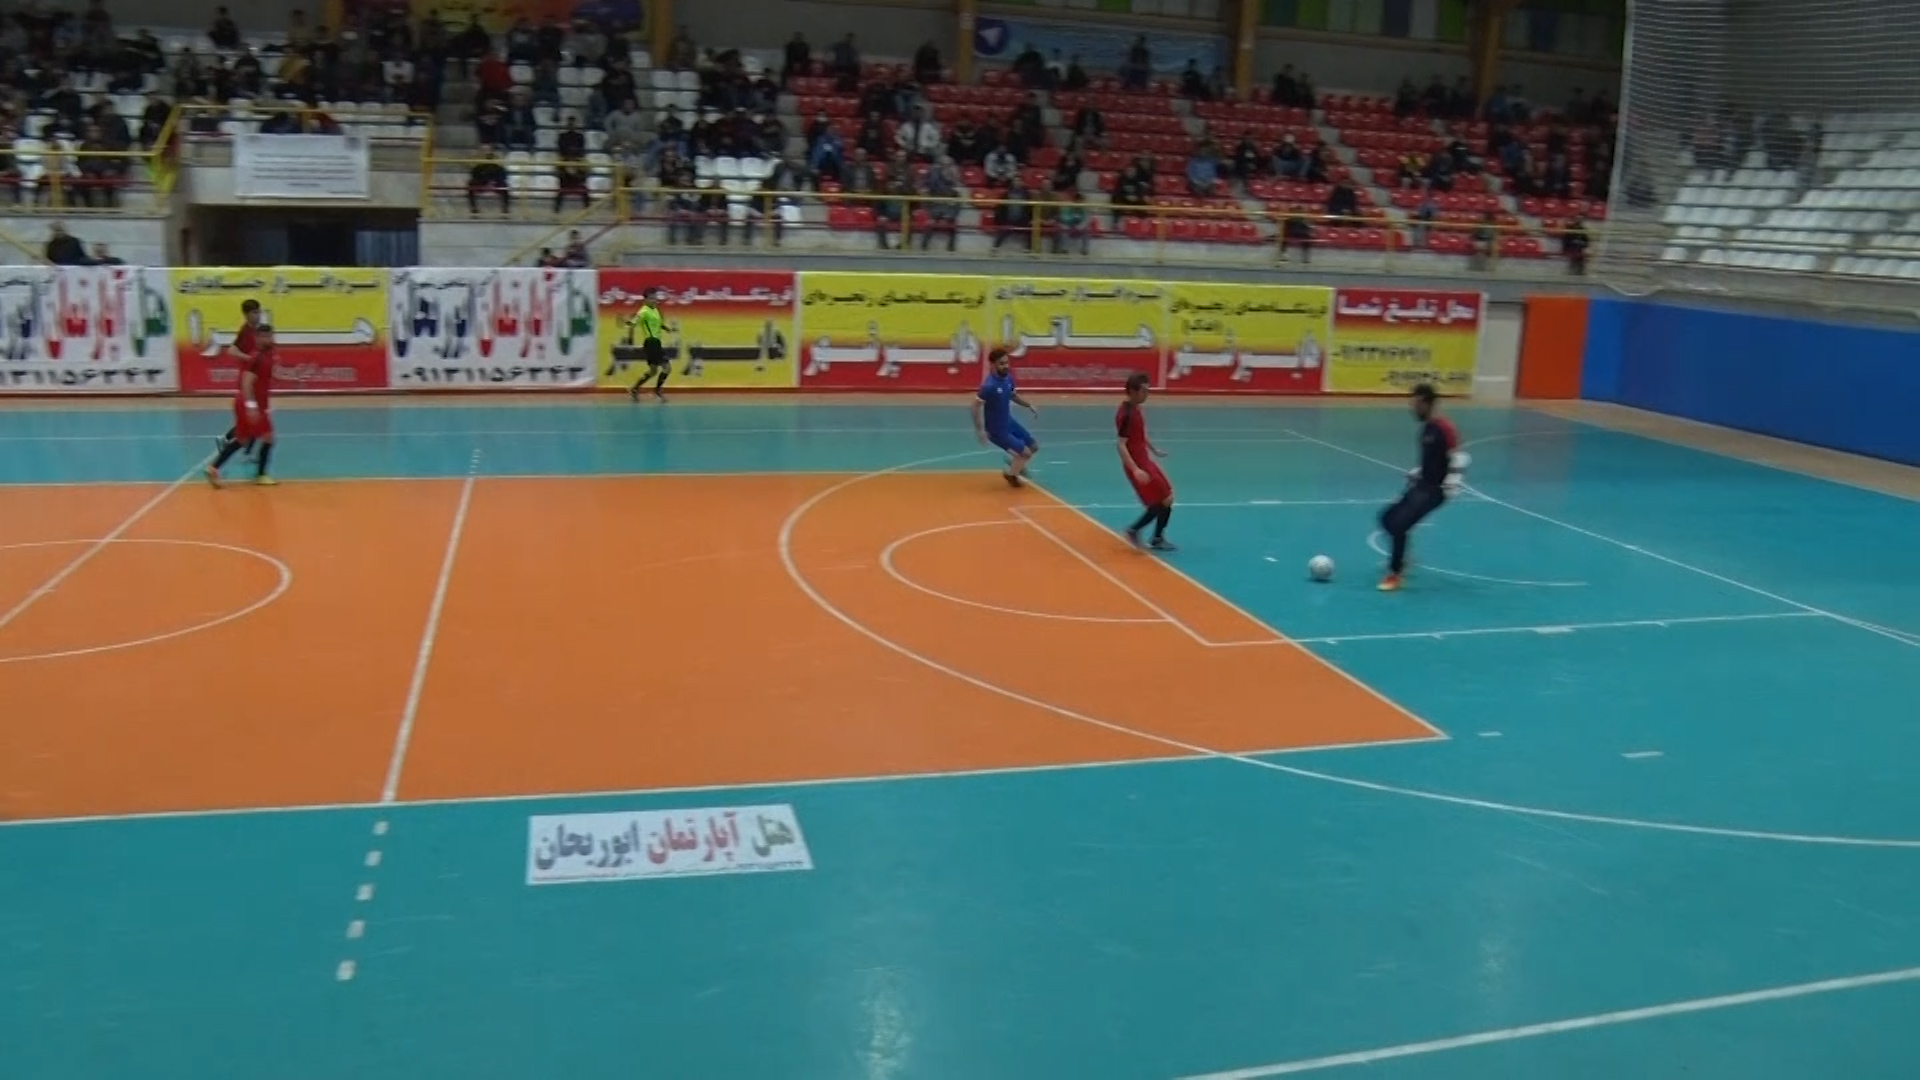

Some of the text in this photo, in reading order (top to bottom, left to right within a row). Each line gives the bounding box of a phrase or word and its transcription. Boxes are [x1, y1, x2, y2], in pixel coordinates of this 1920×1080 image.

[534, 810, 796, 871] هتل آپارتمان ابوریحان
